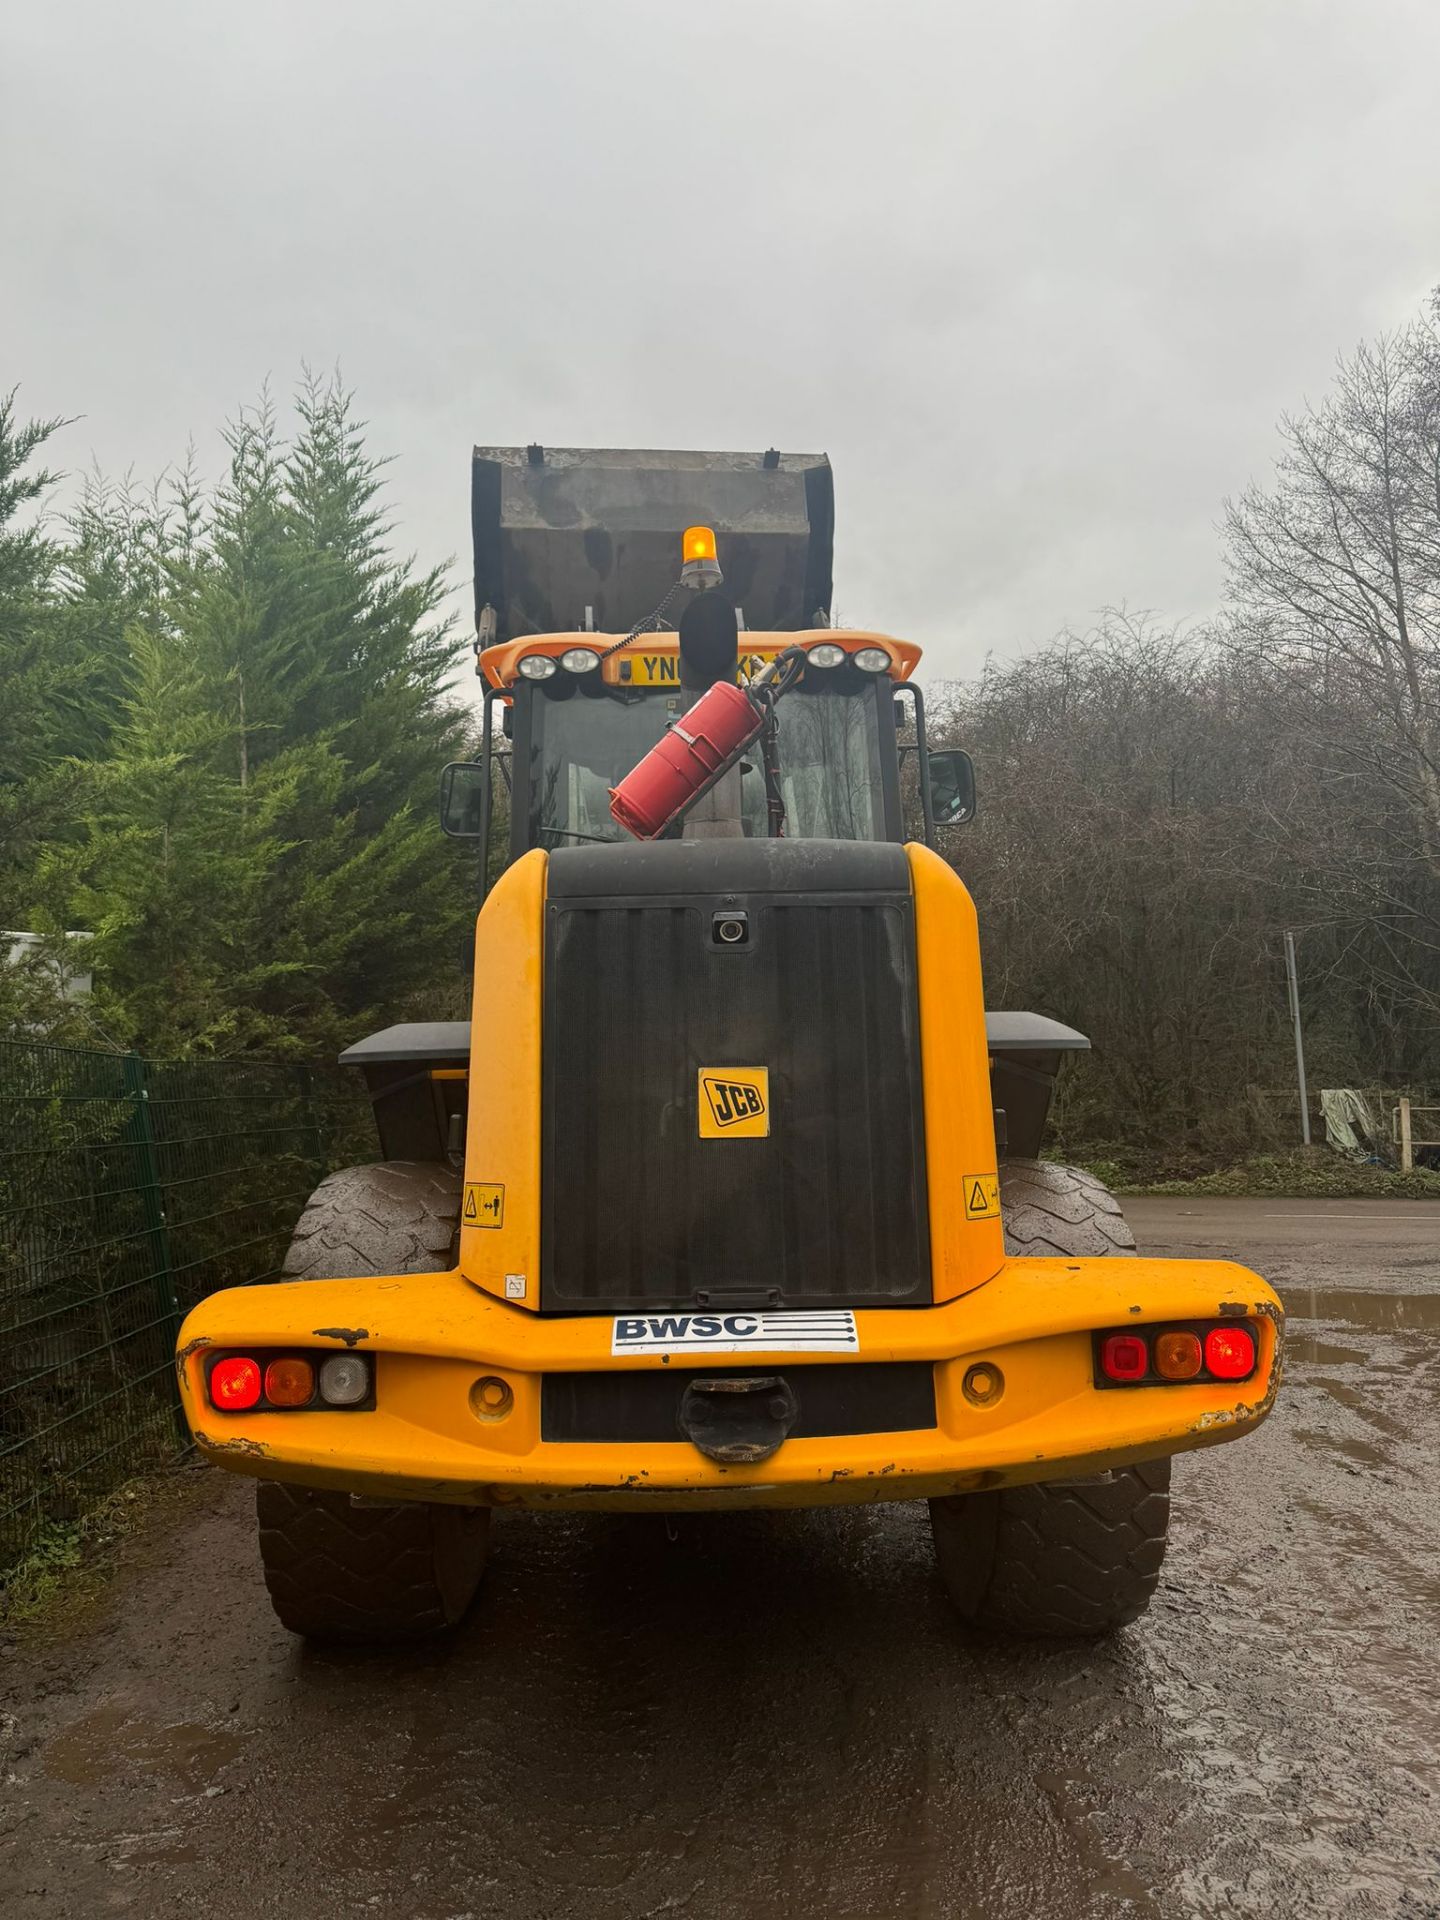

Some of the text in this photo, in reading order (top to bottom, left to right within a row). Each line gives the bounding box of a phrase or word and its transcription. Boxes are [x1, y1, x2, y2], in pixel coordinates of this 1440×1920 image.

[643, 656, 681, 681] YN
[714, 1084, 761, 1121] JCB
[616, 1316, 758, 1340] BWSC
